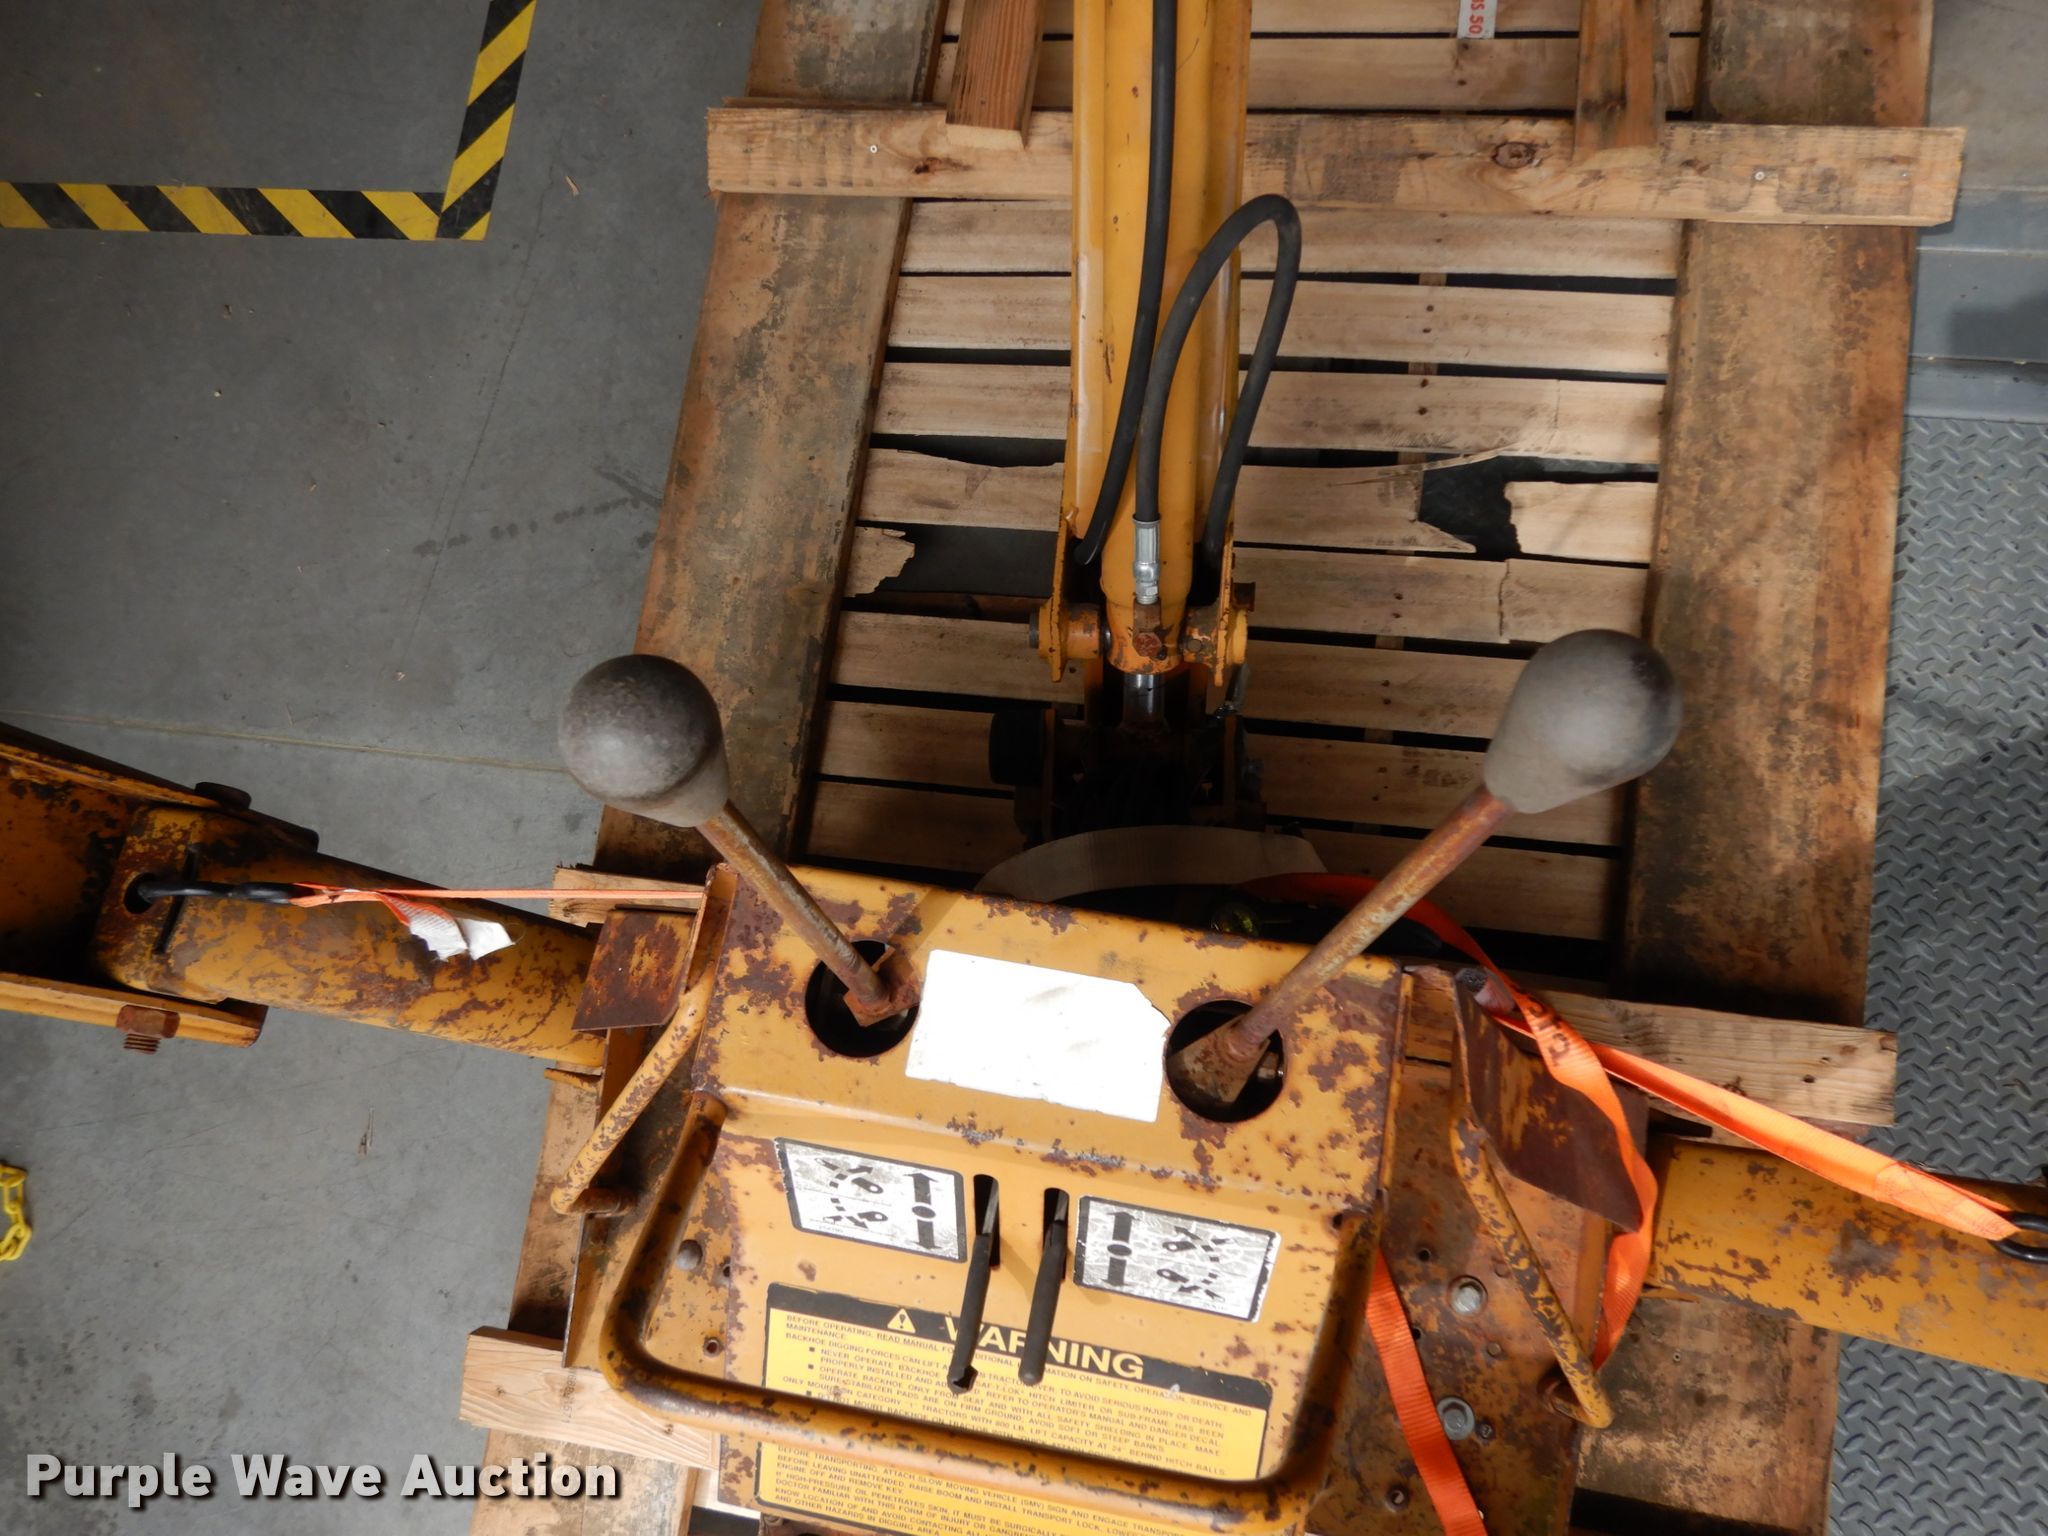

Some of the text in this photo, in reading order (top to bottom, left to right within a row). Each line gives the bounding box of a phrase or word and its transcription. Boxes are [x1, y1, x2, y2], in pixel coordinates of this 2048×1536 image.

[1468, 14, 1484, 34] 50
[785, 1331, 825, 1345] BACKHOE
[828, 1340, 863, 1353] DIGGING
[865, 1348, 900, 1361] FORCES
[902, 1355, 920, 1365] CAN
[922, 1360, 939, 1369] LIFT
[988, 1373, 1027, 1388] TRACTO
[1060, 1388, 1071, 1397] TO
[1073, 1391, 1099, 1403] AVOID
[1101, 1397, 1140, 1411] SERIOUS
[1142, 1405, 1174, 1418] INJURY
[1176, 1412, 1189, 1422] OR
[786, 1314, 819, 1326] BEFORE
[876, 1333, 900, 1343] READ
[903, 1338, 937, 1351] MANUAL
[1079, 1374, 1093, 1384] ON
[1189, 1397, 1228, 1412] SERVICE
[1232, 1406, 1252, 1417] AND
[820, 1348, 849, 1360] NEVER
[854, 1355, 893, 1369] OPERATE
[898, 1365, 939, 1379] BACKHOE
[1028, 1392, 1055, 1403] HITCH
[1059, 1398, 1094, 1412] LIMITER
[1099, 1406, 1112, 1415] OR
[1117, 1410, 1168, 1427] SUB-FRAME
[1174, 1422, 1193, 1432] HAS
[1198, 1427, 1224, 1439] BEEN
[820, 1356, 864, 1370] PROPERLY
[866, 1366, 912, 1381] INSTALLED
[914, 1376, 932, 1385] AND
[985, 1391, 1014, 1403] REFER
[1017, 1398, 1029, 1406] TO
[1031, 1400, 1087, 1418] OPERATOR'S
[1089, 1413, 1125, 1426] MANUAL
[1128, 1421, 1146, 1431] AND
[1149, 1425, 1189, 1440] DANGER
[782, 1375, 803, 1385] ONLY
[807, 1380, 839, 1392] MOUN
[856, 1390, 901, 1406] CATEGORY
[921, 1404, 967, 1420] TRACTORS
[970, 1415, 992, 1425] WITH
[1030, 1428, 1047, 1437] LIFT
[1051, 1432, 1093, 1447] CAPACITY
[1096, 1442, 1107, 1450] AT
[1128, 1449, 1162, 1462] BEHIND
[1165, 1456, 1190, 1468] HITCH
[819, 1365, 858, 1379] OPERATE
[862, 1374, 902, 1388] BACKHOE
[907, 1384, 930, 1394] ONLY
[934, 1390, 958, 1400] FROM
[963, 1396, 984, 1406] SEAT
[989, 1401, 1006, 1411] AND
[1011, 1406, 1033, 1416] WITH
[1036, 1411, 1051, 1420] ALL
[1056, 1415, 1090, 1428] SAFETY
[1094, 1423, 1142, 1439] SHIELDING
[1145, 1434, 1154, 1442] IN
[1194, 1444, 1221, 1456] MAKE
[847, 1379, 892, 1394] STABILIZER
[896, 1389, 919, 1400] PADS
[923, 1395, 939, 1404] ARE
[943, 1399, 957, 1408] ON
[960, 1403, 981, 1413] FIRM
[1028, 1417, 1054, 1429] AVOID
[1058, 1424, 1080, 1434] SOFT
[1084, 1429, 1098, 1438] OR
[1101, 1433, 1130, 1445] STEEP
[775, 1477, 986, 1530] DOCTOR FAMILIAR WITH THIS FORM OF INJURY OR
[776, 1461, 806, 1473] ENGINE
[809, 1468, 824, 1478] OFF
[828, 1473, 845, 1482] AND
[848, 1477, 882, 1491] REMOVE
[777, 1453, 809, 1466] BEFORE
[812, 1461, 847, 1475] LEAVING
[909, 1483, 932, 1494] RAISE
[936, 1489, 962, 1500] BOOM
[964, 1495, 981, 1505] AND
[984, 1499, 1017, 1513] INSTALL
[1022, 1508, 1072, 1525] TRANSPORT
[786, 1472, 851, 1492] HIGH-PRESSURE
[854, 1487, 866, 1496] OIL
[871, 1491, 924, 1509] PENETRATES
[952, 1509, 959, 1517] IT
[963, 1512, 986, 1523] MUST
[989, 1518, 1001, 1526] BE
[883, 1468, 915, 1481] ATTACH
[918, 1475, 943, 1487] SLOW
[945, 1481, 978, 1495] MOVING
[982, 1489, 1017, 1503] VEHICLE
[1020, 1498, 1044, 1509] (SMV)
[1047, 1504, 1068, 1514] SIGN
[1070, 1509, 1088, 1519] AND
[1092, 1514, 1128, 1528] ENGAGE
[774, 1493, 791, 1503] AND
[794, 1498, 822, 1510] OTHER
[825, 1505, 863, 1519] HAZARDS
[867, 1514, 876, 1522] IN
[878, 1517, 913, 1531] DIGGING
[775, 1486, 800, 1497] KNOW
[803, 1492, 843, 1507] LOCATION
[847, 1502, 858, 1510] OF
[861, 1505, 878, 1515] AND
[881, 1510, 906, 1521] AVOID
[910, 1516, 963, 1534] CONTACTING
